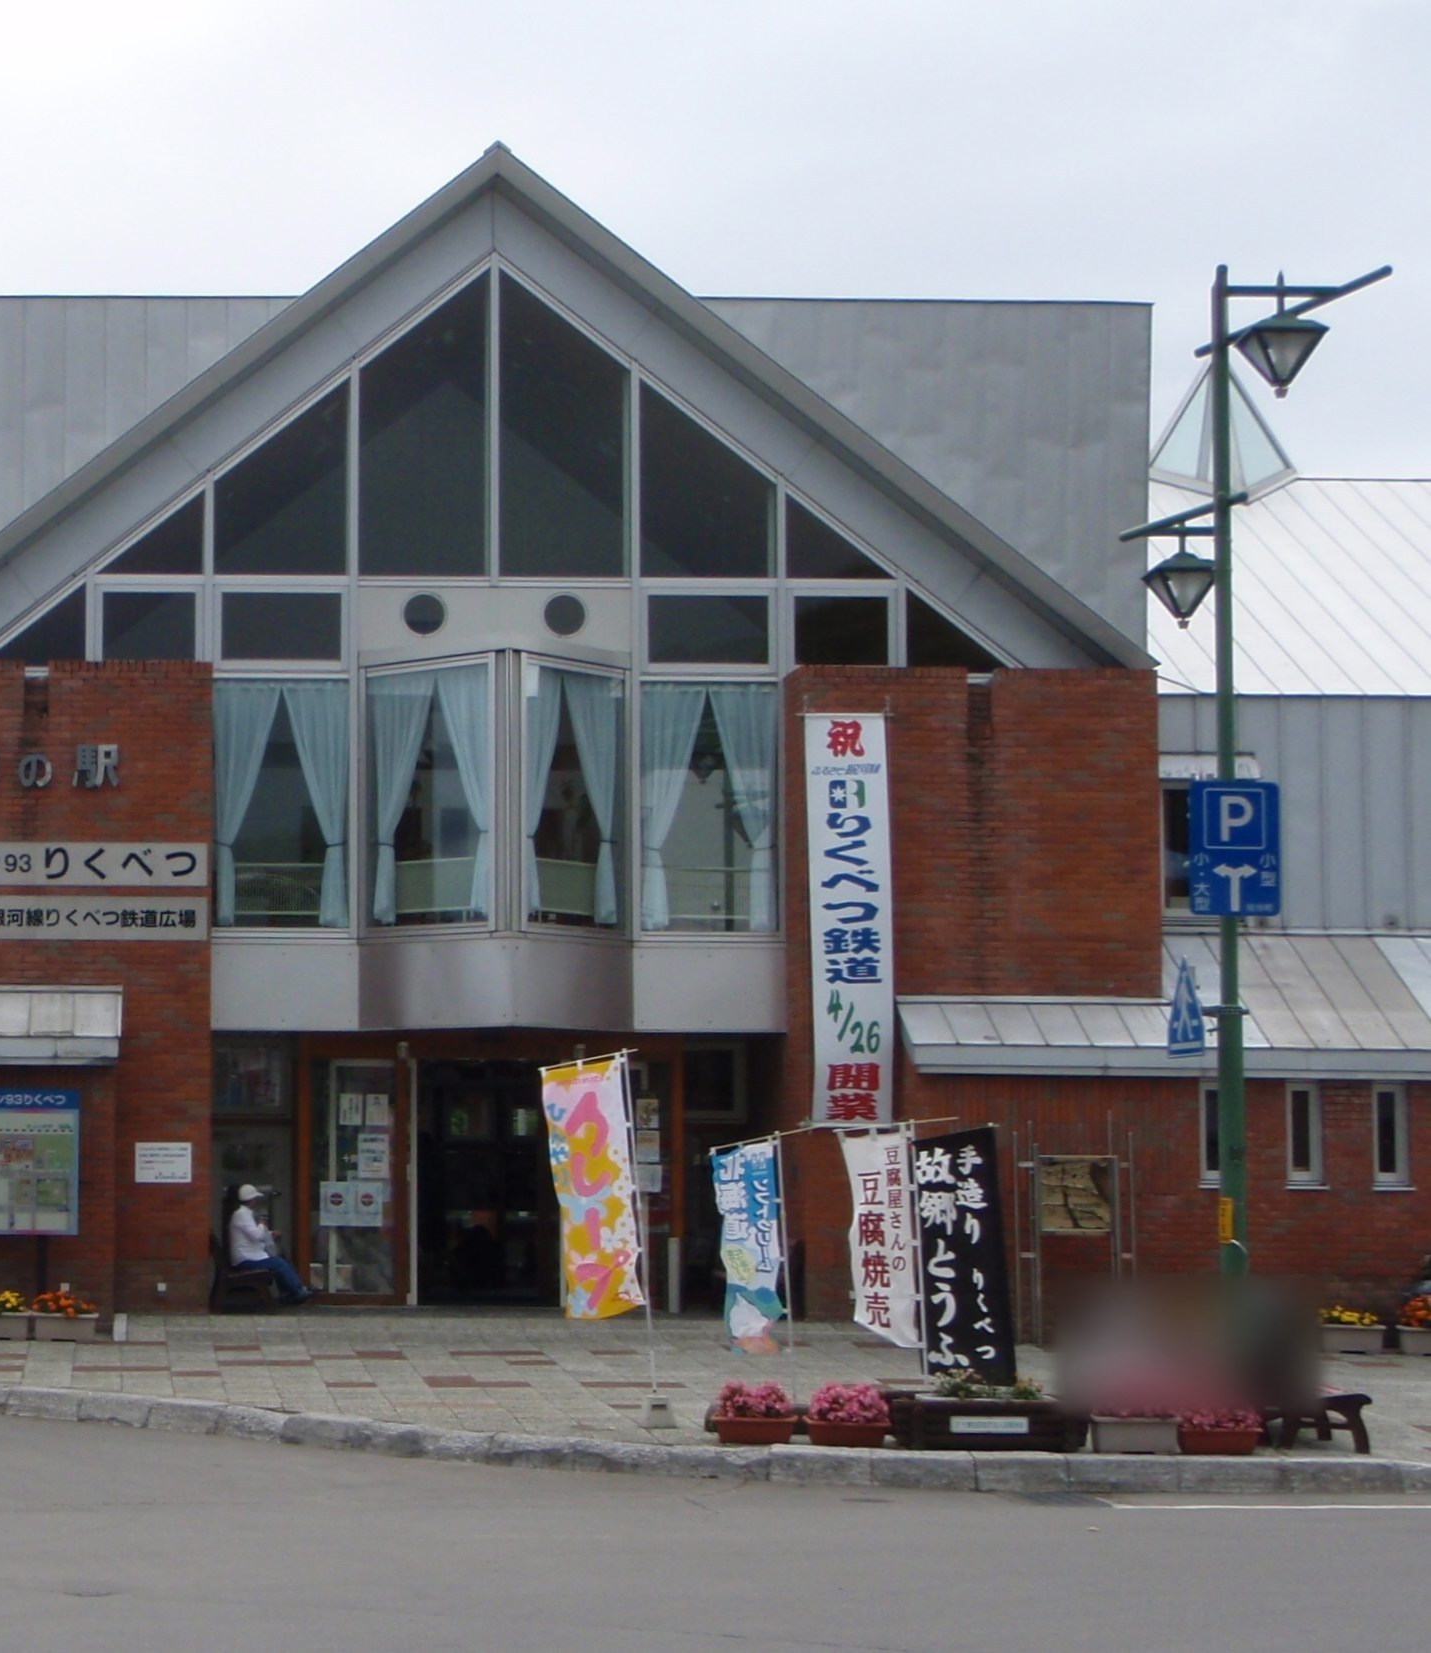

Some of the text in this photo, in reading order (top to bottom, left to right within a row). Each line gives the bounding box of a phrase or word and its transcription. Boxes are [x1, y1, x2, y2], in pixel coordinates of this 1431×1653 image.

[827, 720, 865, 757] 祝
[1221, 795, 1254, 842] P
[821, 812, 882, 985] りくべつ鉄道
[1259, 853, 1277, 887] 小型
[826, 989, 881, 1055] 4/26
[826, 1063, 881, 1121] 開業
[857, 1170, 891, 1330] 豆腐焼売
[884, 1145, 907, 1272] 豆腐屋さんの
[955, 1144, 996, 1359] 手造り りくべつ
[915, 1147, 970, 1368] 故郷とうふ
